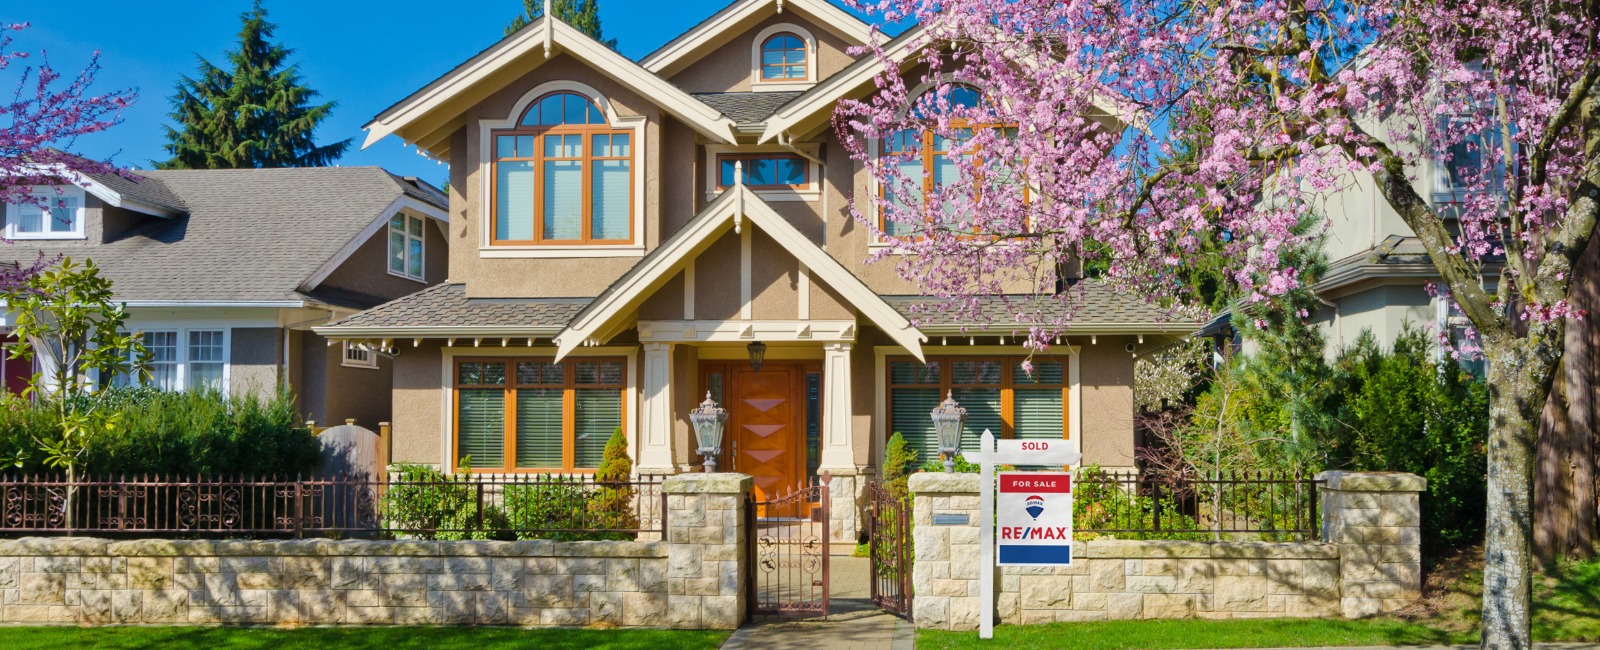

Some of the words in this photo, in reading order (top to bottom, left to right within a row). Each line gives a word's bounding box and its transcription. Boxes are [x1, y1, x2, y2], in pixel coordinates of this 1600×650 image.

[1021, 442, 1049, 451] SOLD
[1012, 480, 1031, 488] FOR
[1033, 480, 1057, 488] SALE
[1001, 526, 1067, 540] RE/MAX
